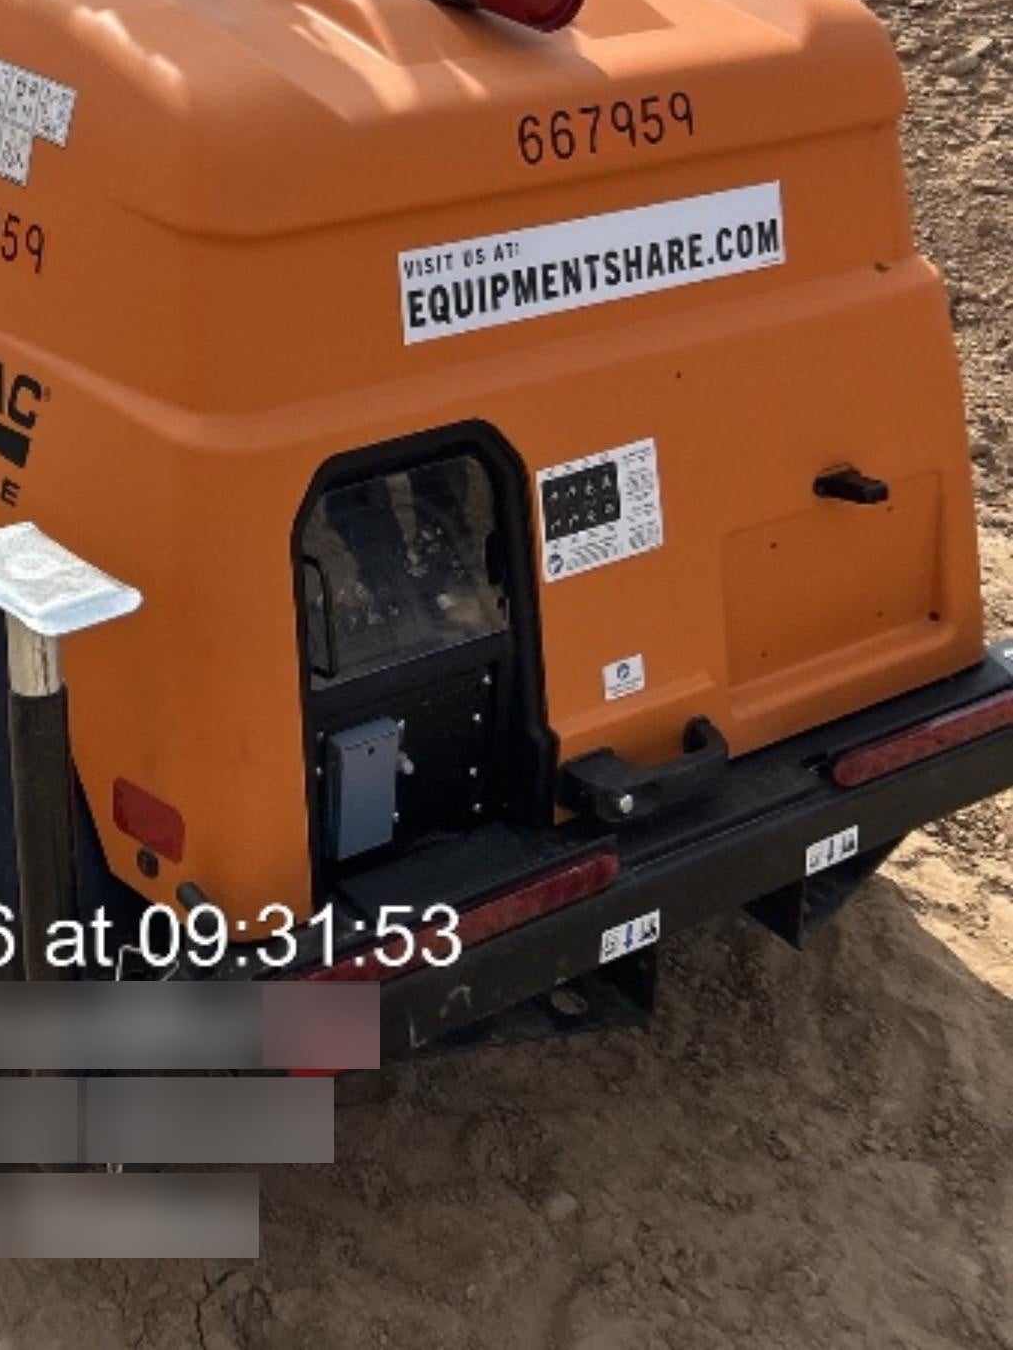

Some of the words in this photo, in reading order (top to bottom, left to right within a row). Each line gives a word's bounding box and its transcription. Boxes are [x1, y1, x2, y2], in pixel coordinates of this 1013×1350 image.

[518, 92, 694, 165] 667959
[404, 253, 453, 280] VISIT
[463, 249, 486, 268] US
[407, 218, 780, 328] EQUIPMENTSHARE.COM
